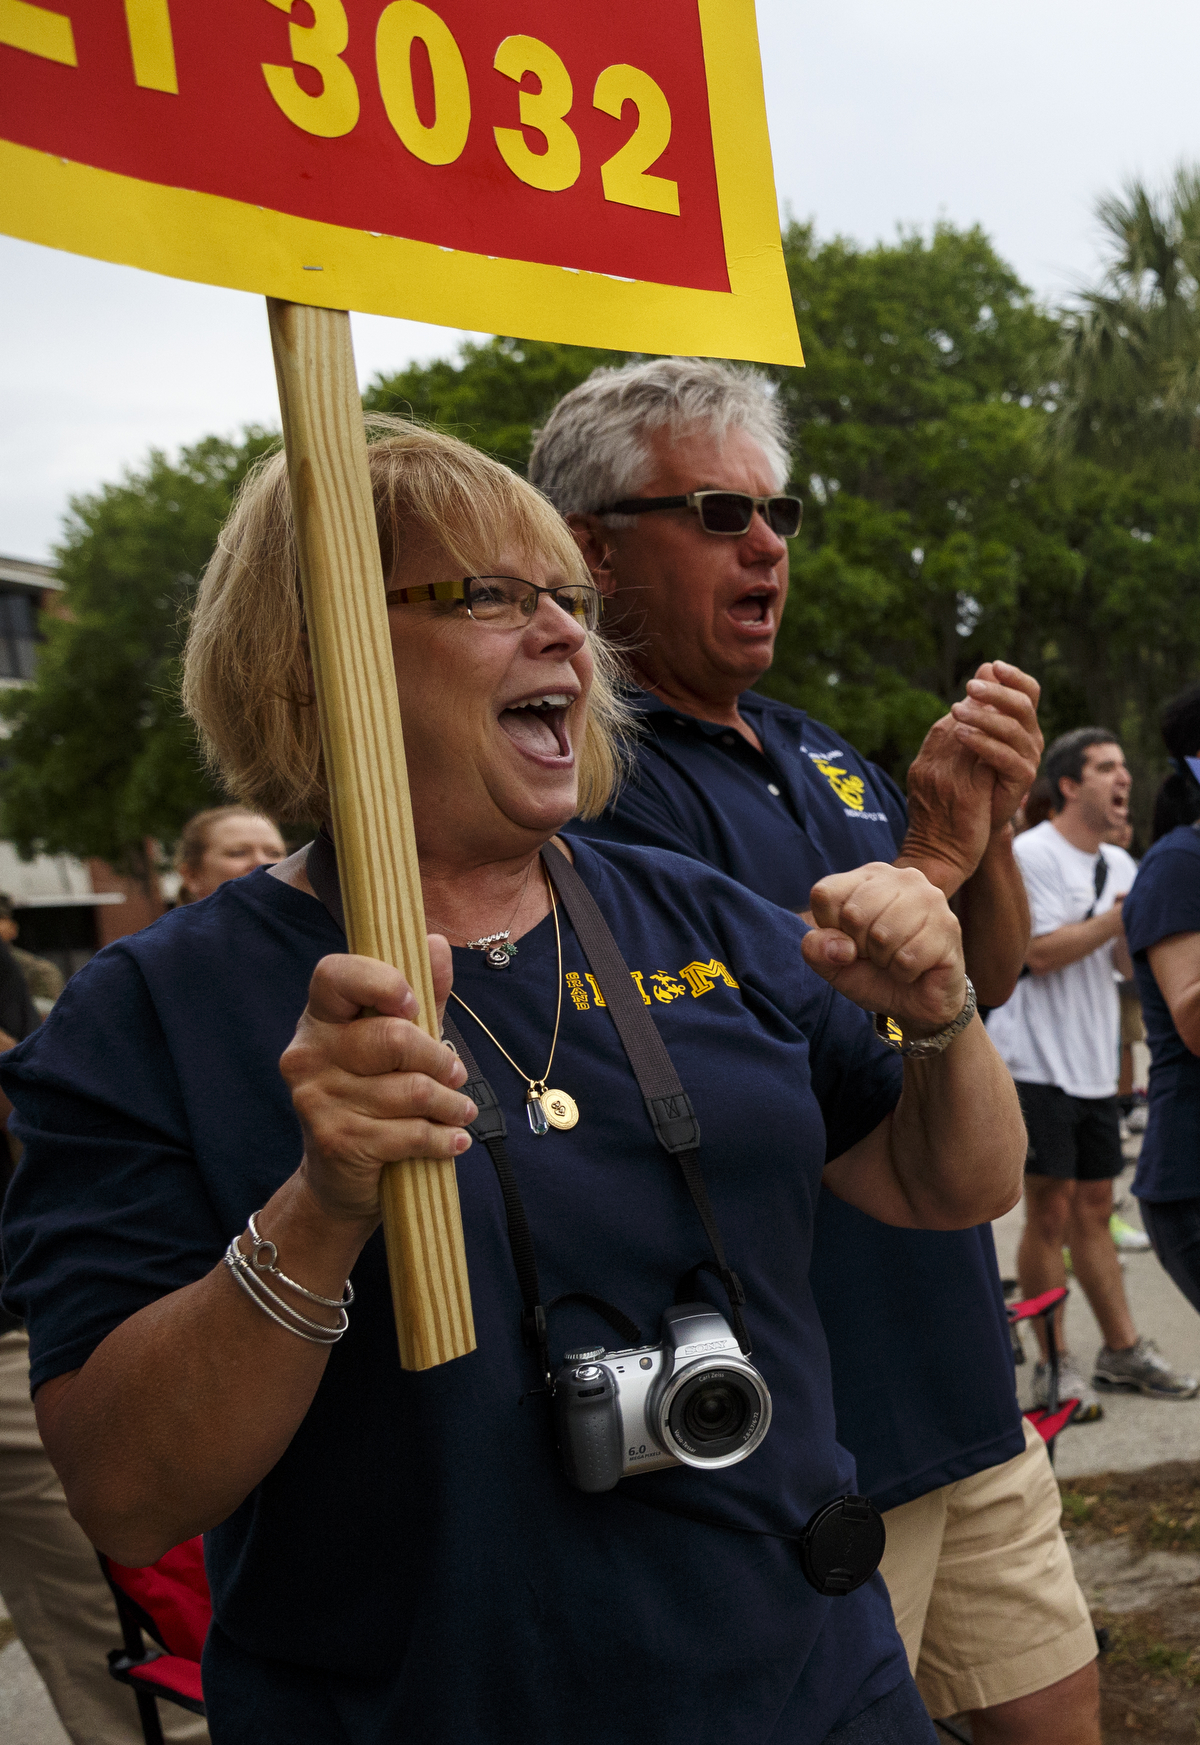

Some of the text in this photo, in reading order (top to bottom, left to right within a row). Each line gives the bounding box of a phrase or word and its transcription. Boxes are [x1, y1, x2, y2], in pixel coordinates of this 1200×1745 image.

[261, 0, 681, 216] 3032
[565, 971, 590, 1011] GRAND
[684, 1339, 728, 1355] SONY
[698, 1373, 710, 1382] Carl
[628, 1444, 646, 1456] 6.0
[673, 1429, 697, 1453] Vario-Tessar
